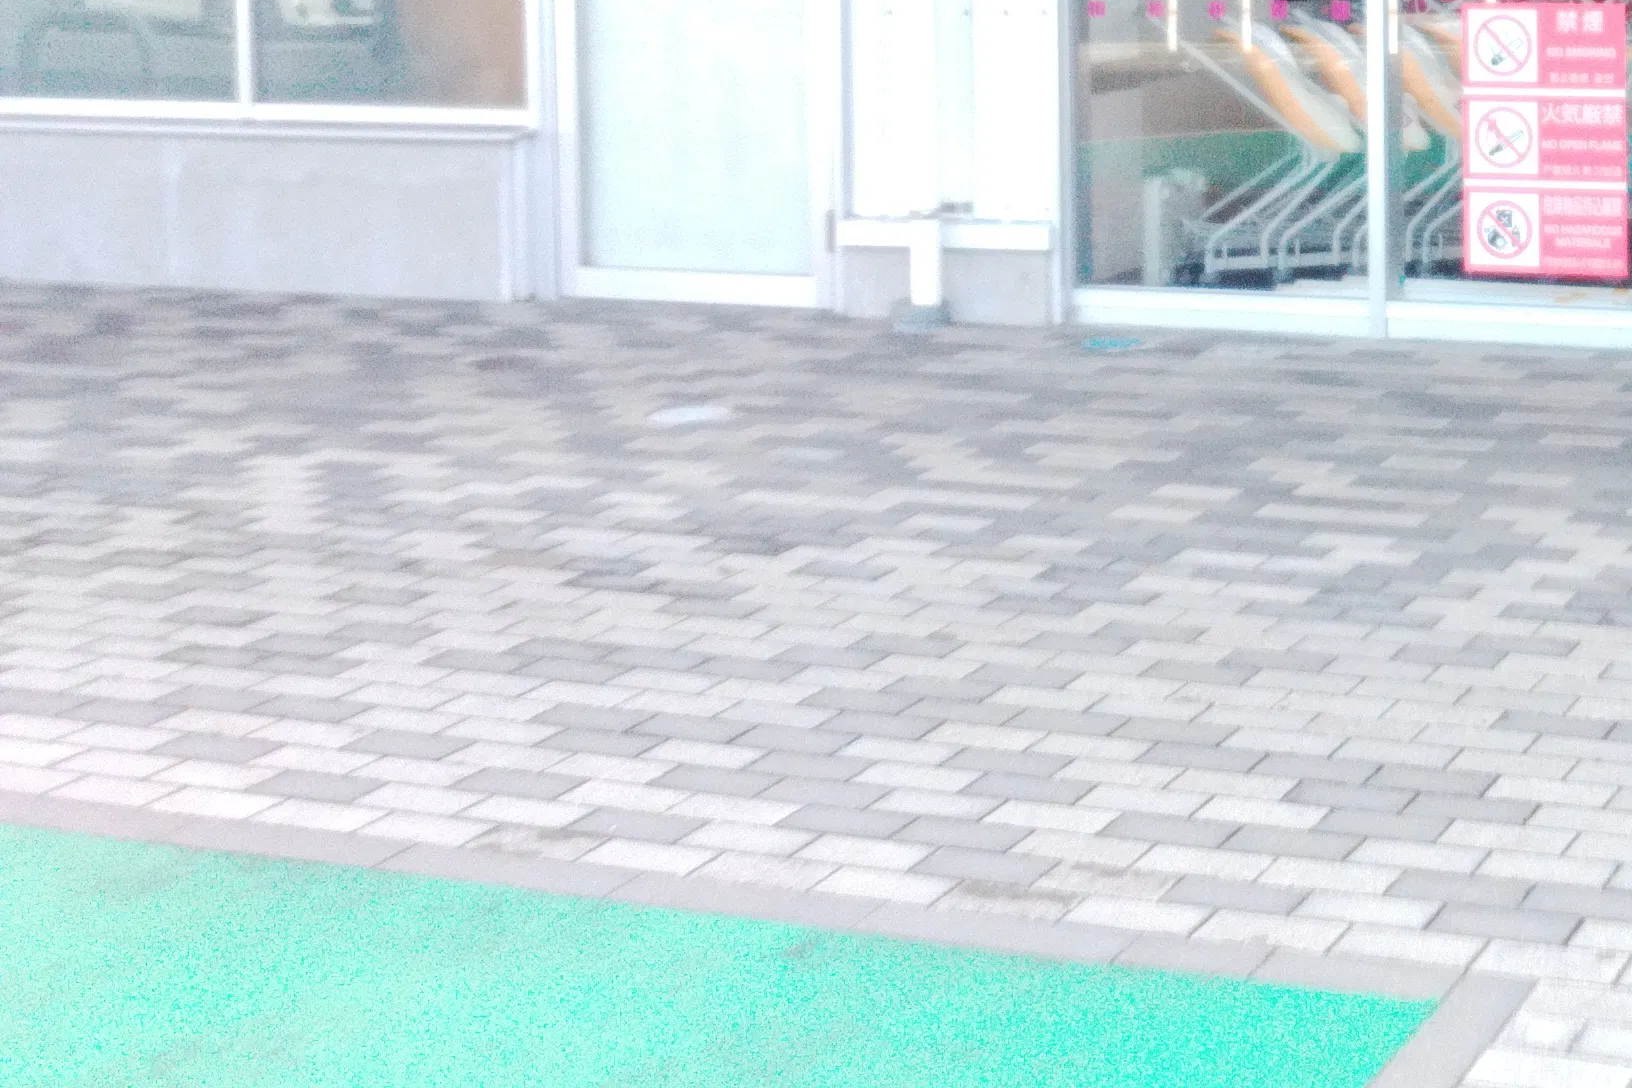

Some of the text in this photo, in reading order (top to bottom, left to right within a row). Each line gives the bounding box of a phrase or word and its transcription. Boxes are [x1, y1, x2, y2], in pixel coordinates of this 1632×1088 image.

[1556, 10, 1604, 33] 禁煙
[1541, 103, 1623, 125] 火気厳禁
[1541, 139, 1623, 152] NO OPEN FLAME
